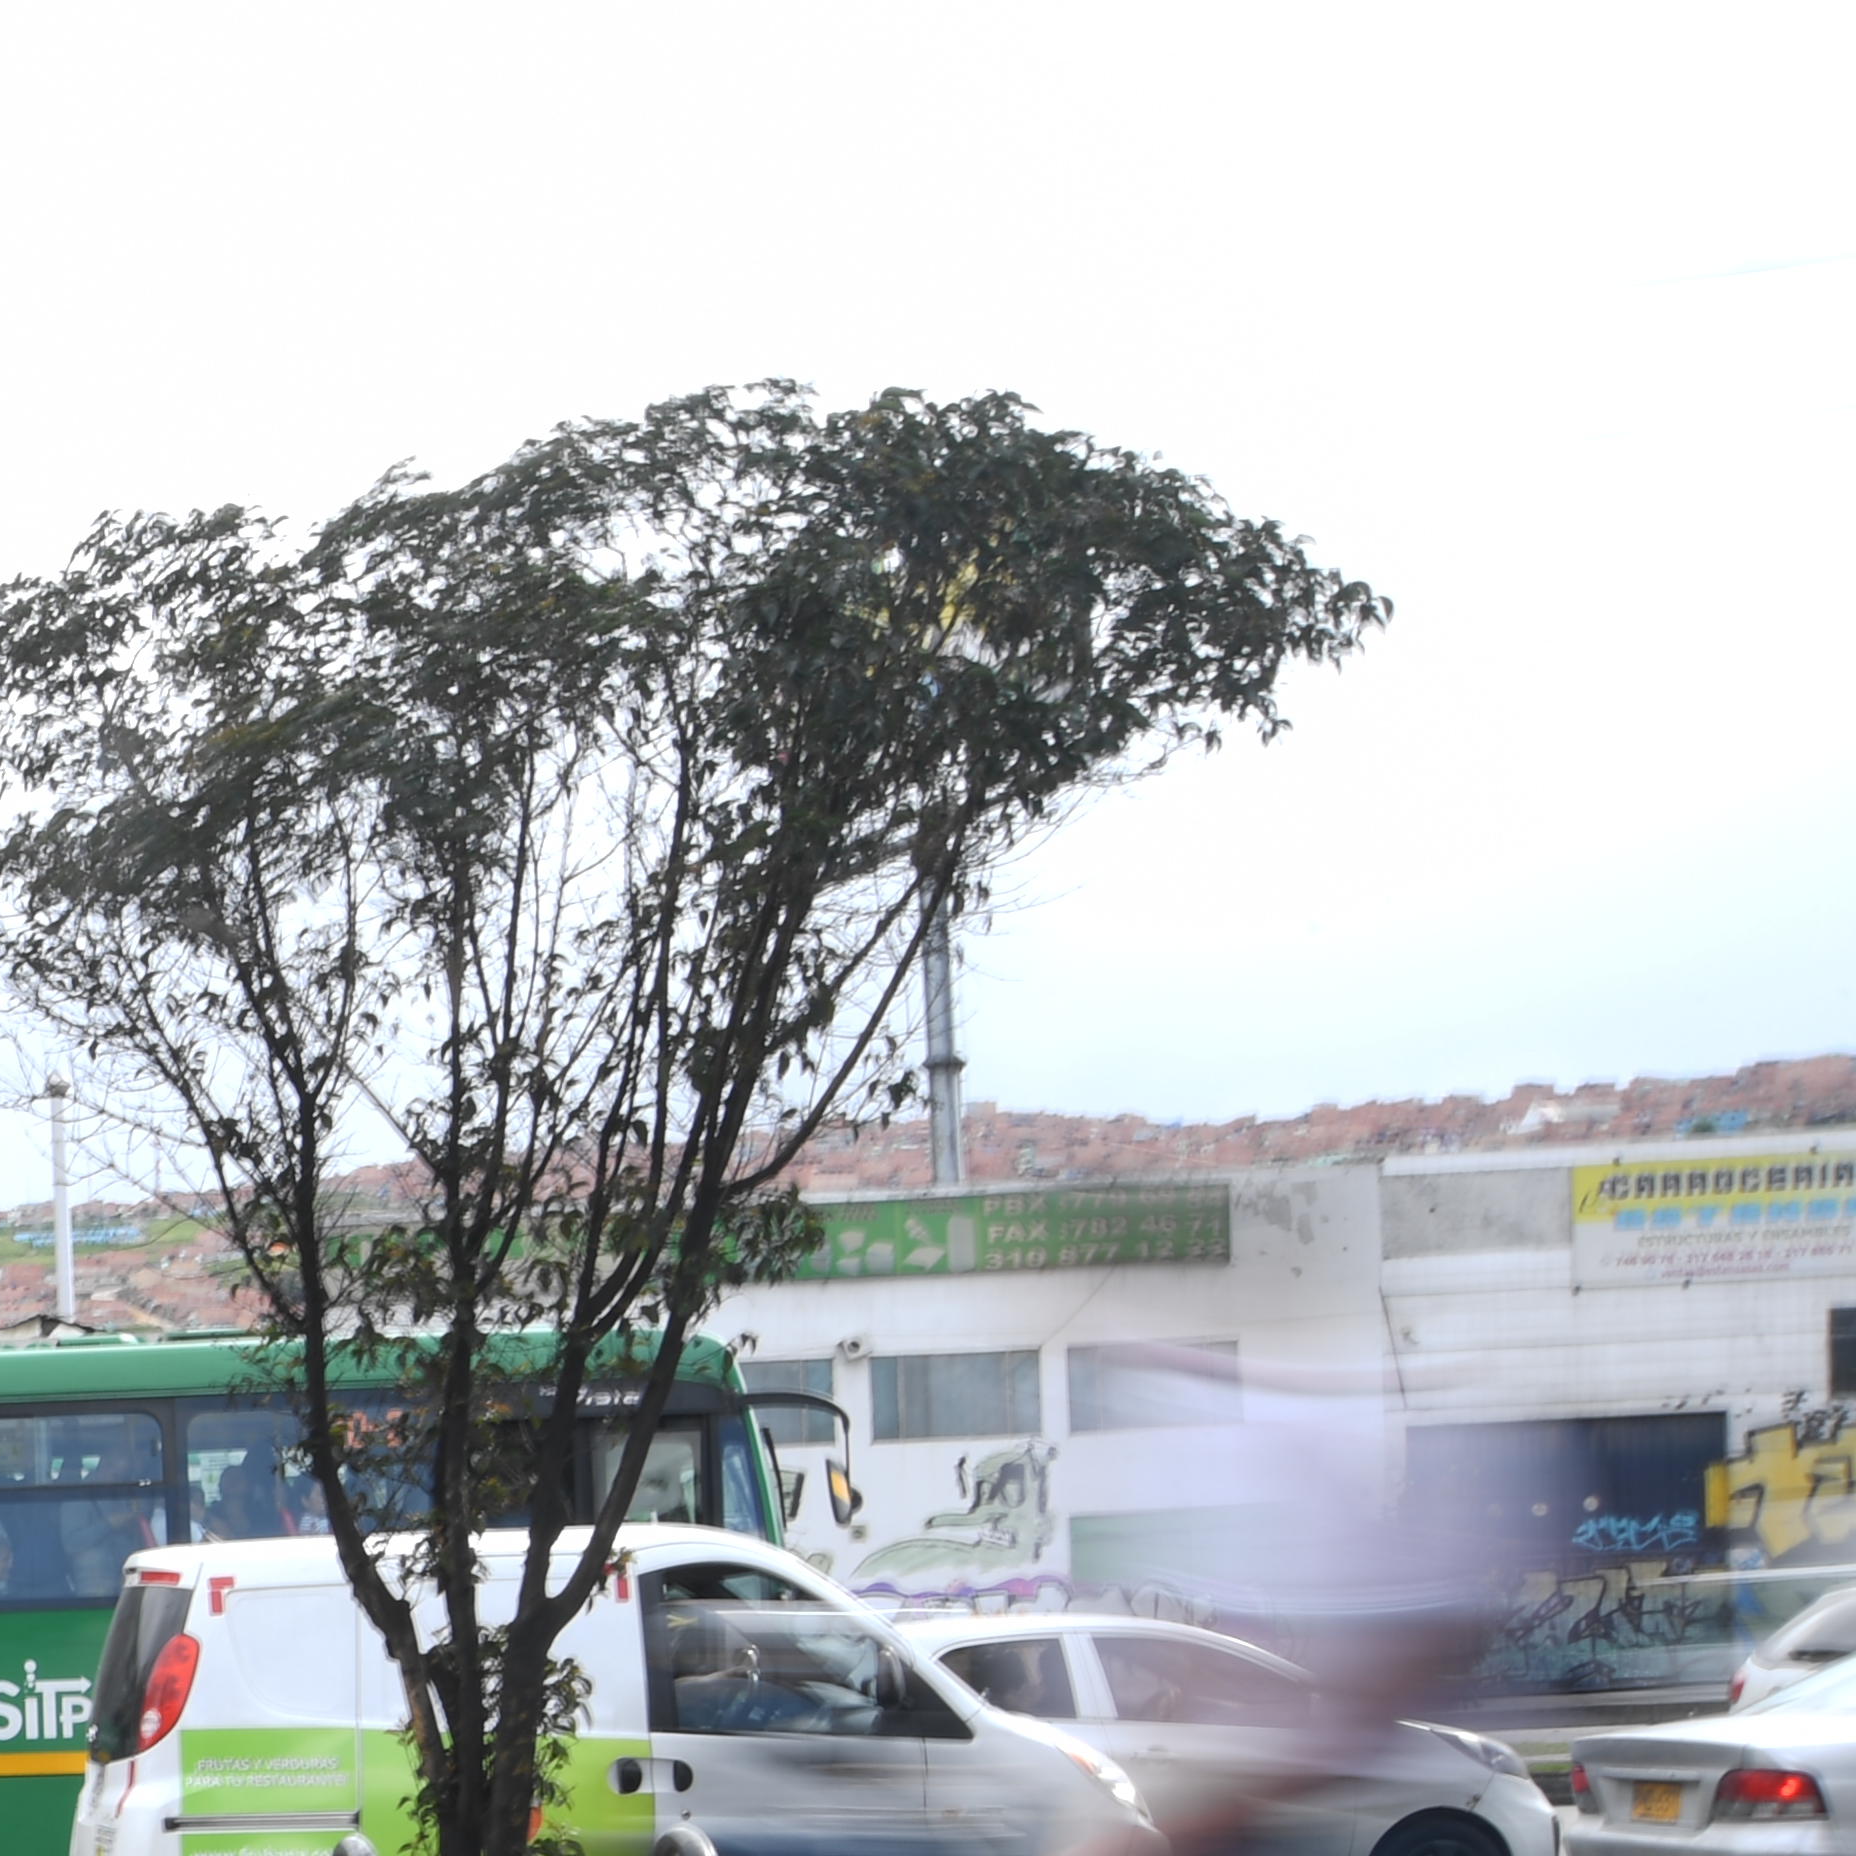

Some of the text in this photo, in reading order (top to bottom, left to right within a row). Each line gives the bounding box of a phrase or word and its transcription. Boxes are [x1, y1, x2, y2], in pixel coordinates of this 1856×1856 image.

[983, 1194, 1049, 1217] PBX
[988, 1220, 1049, 1244] FAX
[1187, 1212, 1224, 1237] 71
[266, 1756, 339, 1771] VERDURAS
[185, 1775, 221, 1788] PARA
[225, 1774, 243, 1788] TU
